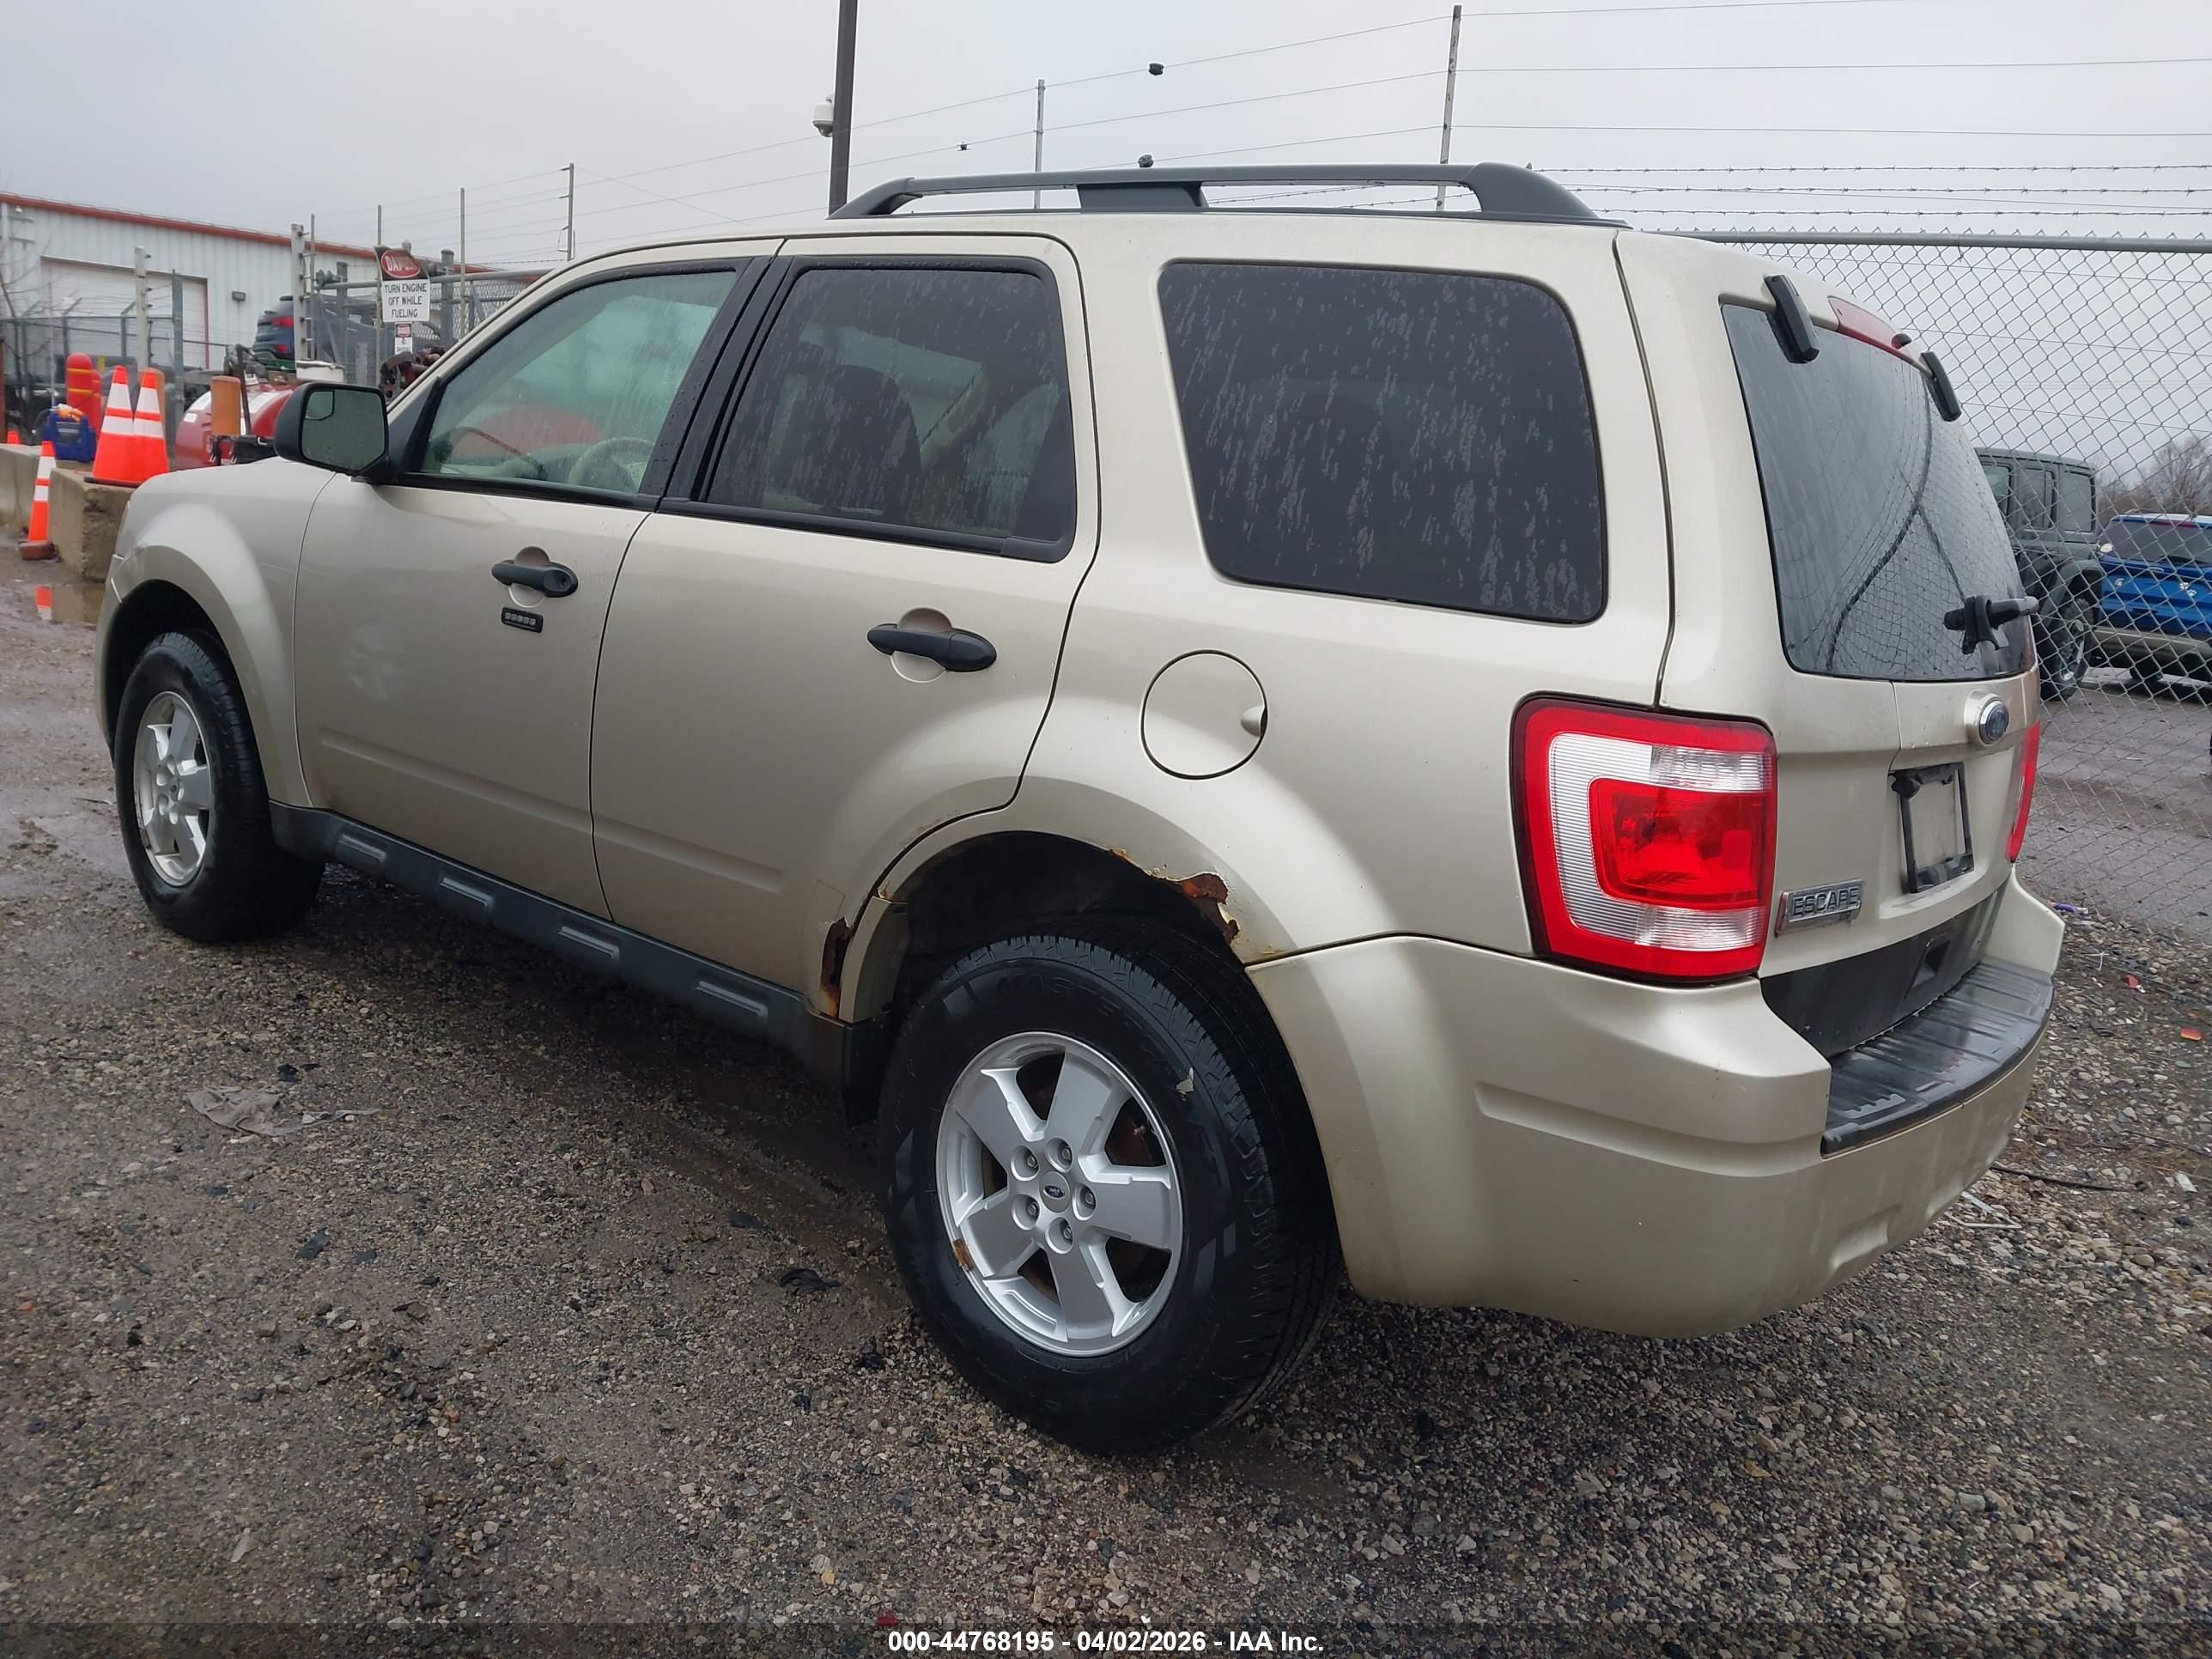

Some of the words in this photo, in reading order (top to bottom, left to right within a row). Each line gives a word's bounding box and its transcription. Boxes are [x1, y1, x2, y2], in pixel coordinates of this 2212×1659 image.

[385, 284, 401, 294] TURN
[402, 283, 428, 293] ENGINE
[388, 296, 399, 307] OFF
[402, 295, 423, 306] WHILE
[392, 308, 418, 319] FUELING
[1792, 885, 1860, 916] ESCAPE
